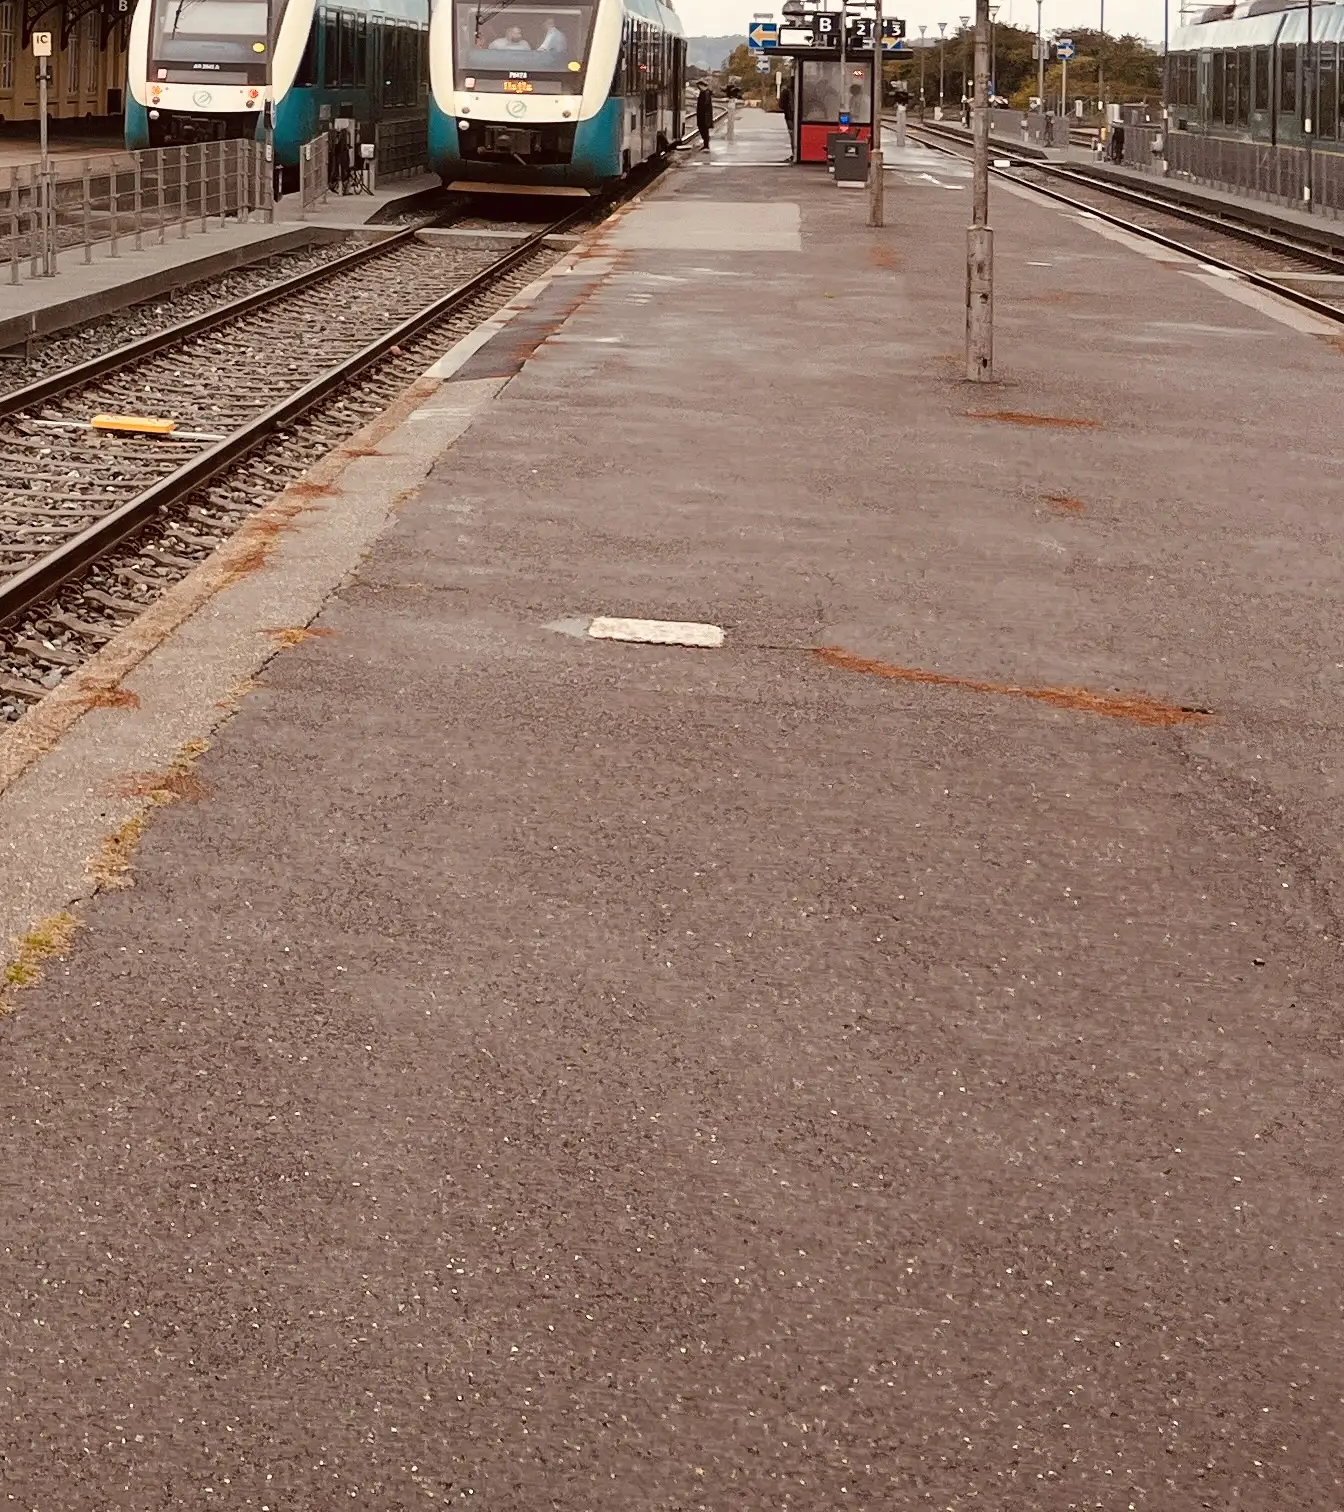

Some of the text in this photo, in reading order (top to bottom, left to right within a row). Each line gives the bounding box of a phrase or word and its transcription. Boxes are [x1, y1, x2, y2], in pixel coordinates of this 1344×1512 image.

[118, 0, 128, 11] B
[819, 17, 832, 32] B
[856, 24, 866, 36] 2
[892, 25, 901, 36] 3
